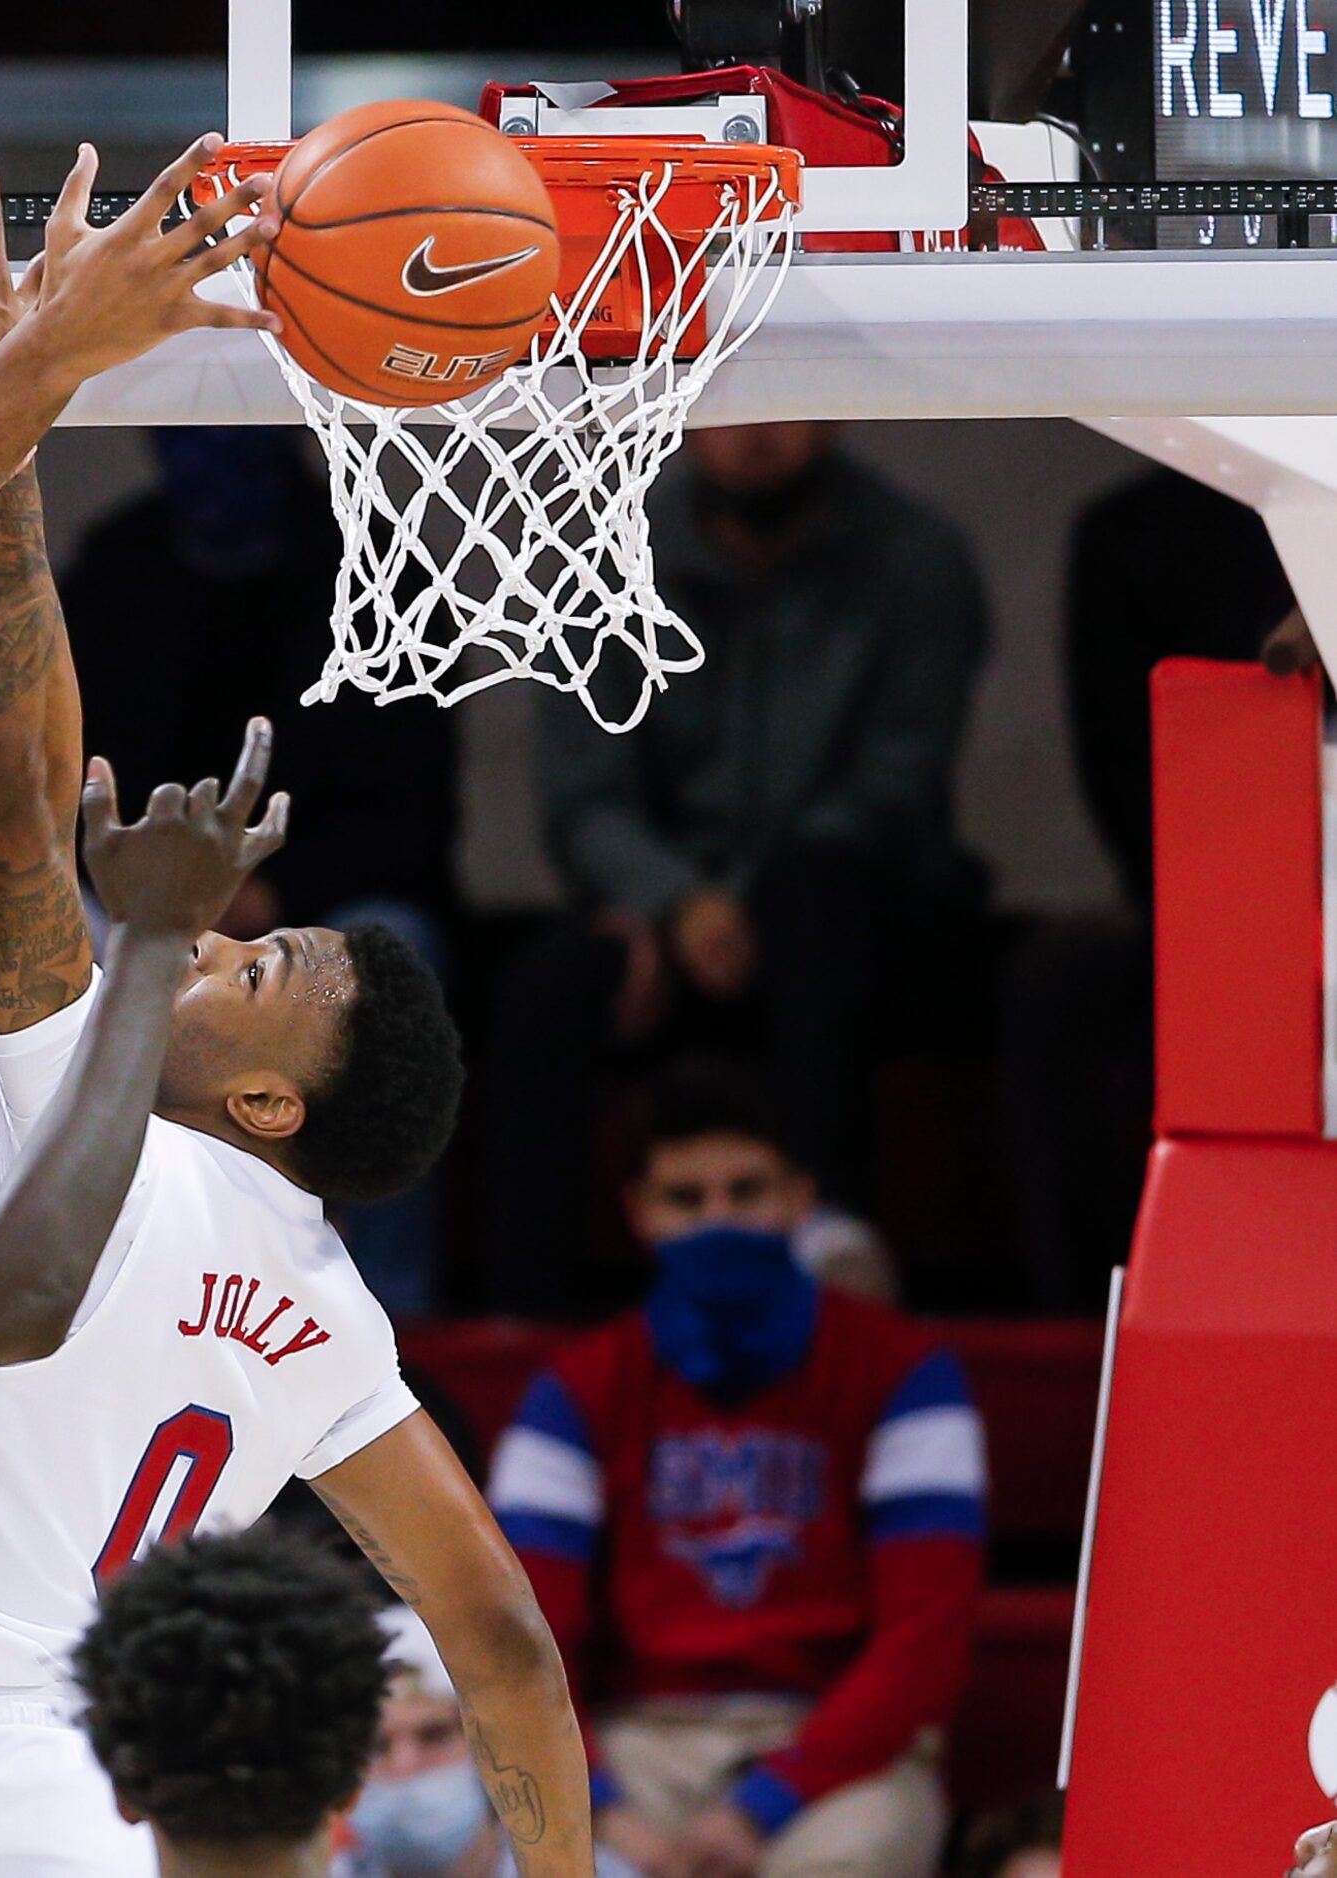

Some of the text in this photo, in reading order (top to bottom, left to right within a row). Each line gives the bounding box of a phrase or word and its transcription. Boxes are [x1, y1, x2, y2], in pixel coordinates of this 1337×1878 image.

[382, 343, 512, 382] ELITE
[178, 1273, 332, 1366] JOLLY
[91, 1402, 234, 1598] 0
